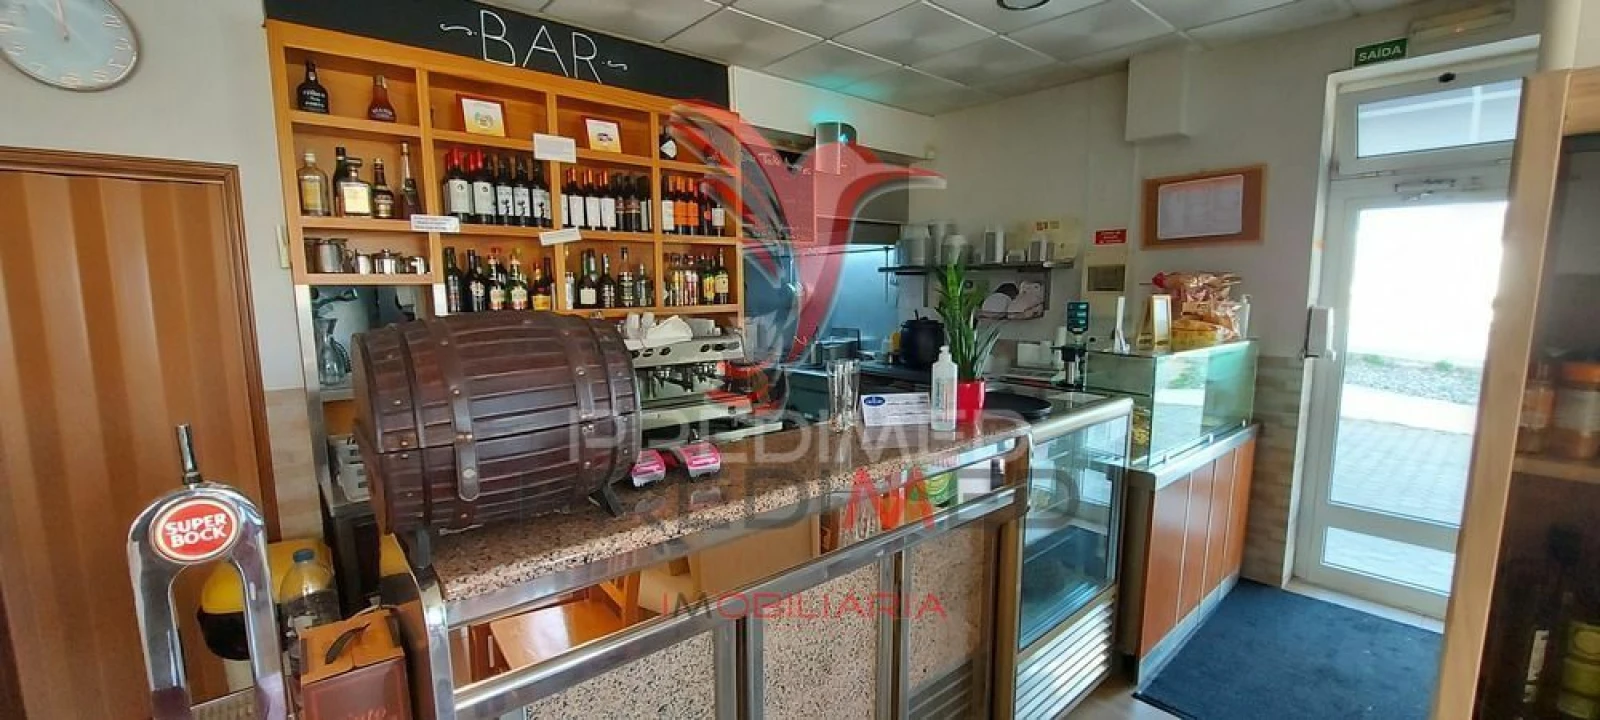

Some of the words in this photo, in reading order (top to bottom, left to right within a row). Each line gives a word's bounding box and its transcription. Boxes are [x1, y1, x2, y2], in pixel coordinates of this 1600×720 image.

[479, 9, 602, 84] BAR
[165, 513, 227, 535] SUPER
[170, 525, 227, 548] BOCK
